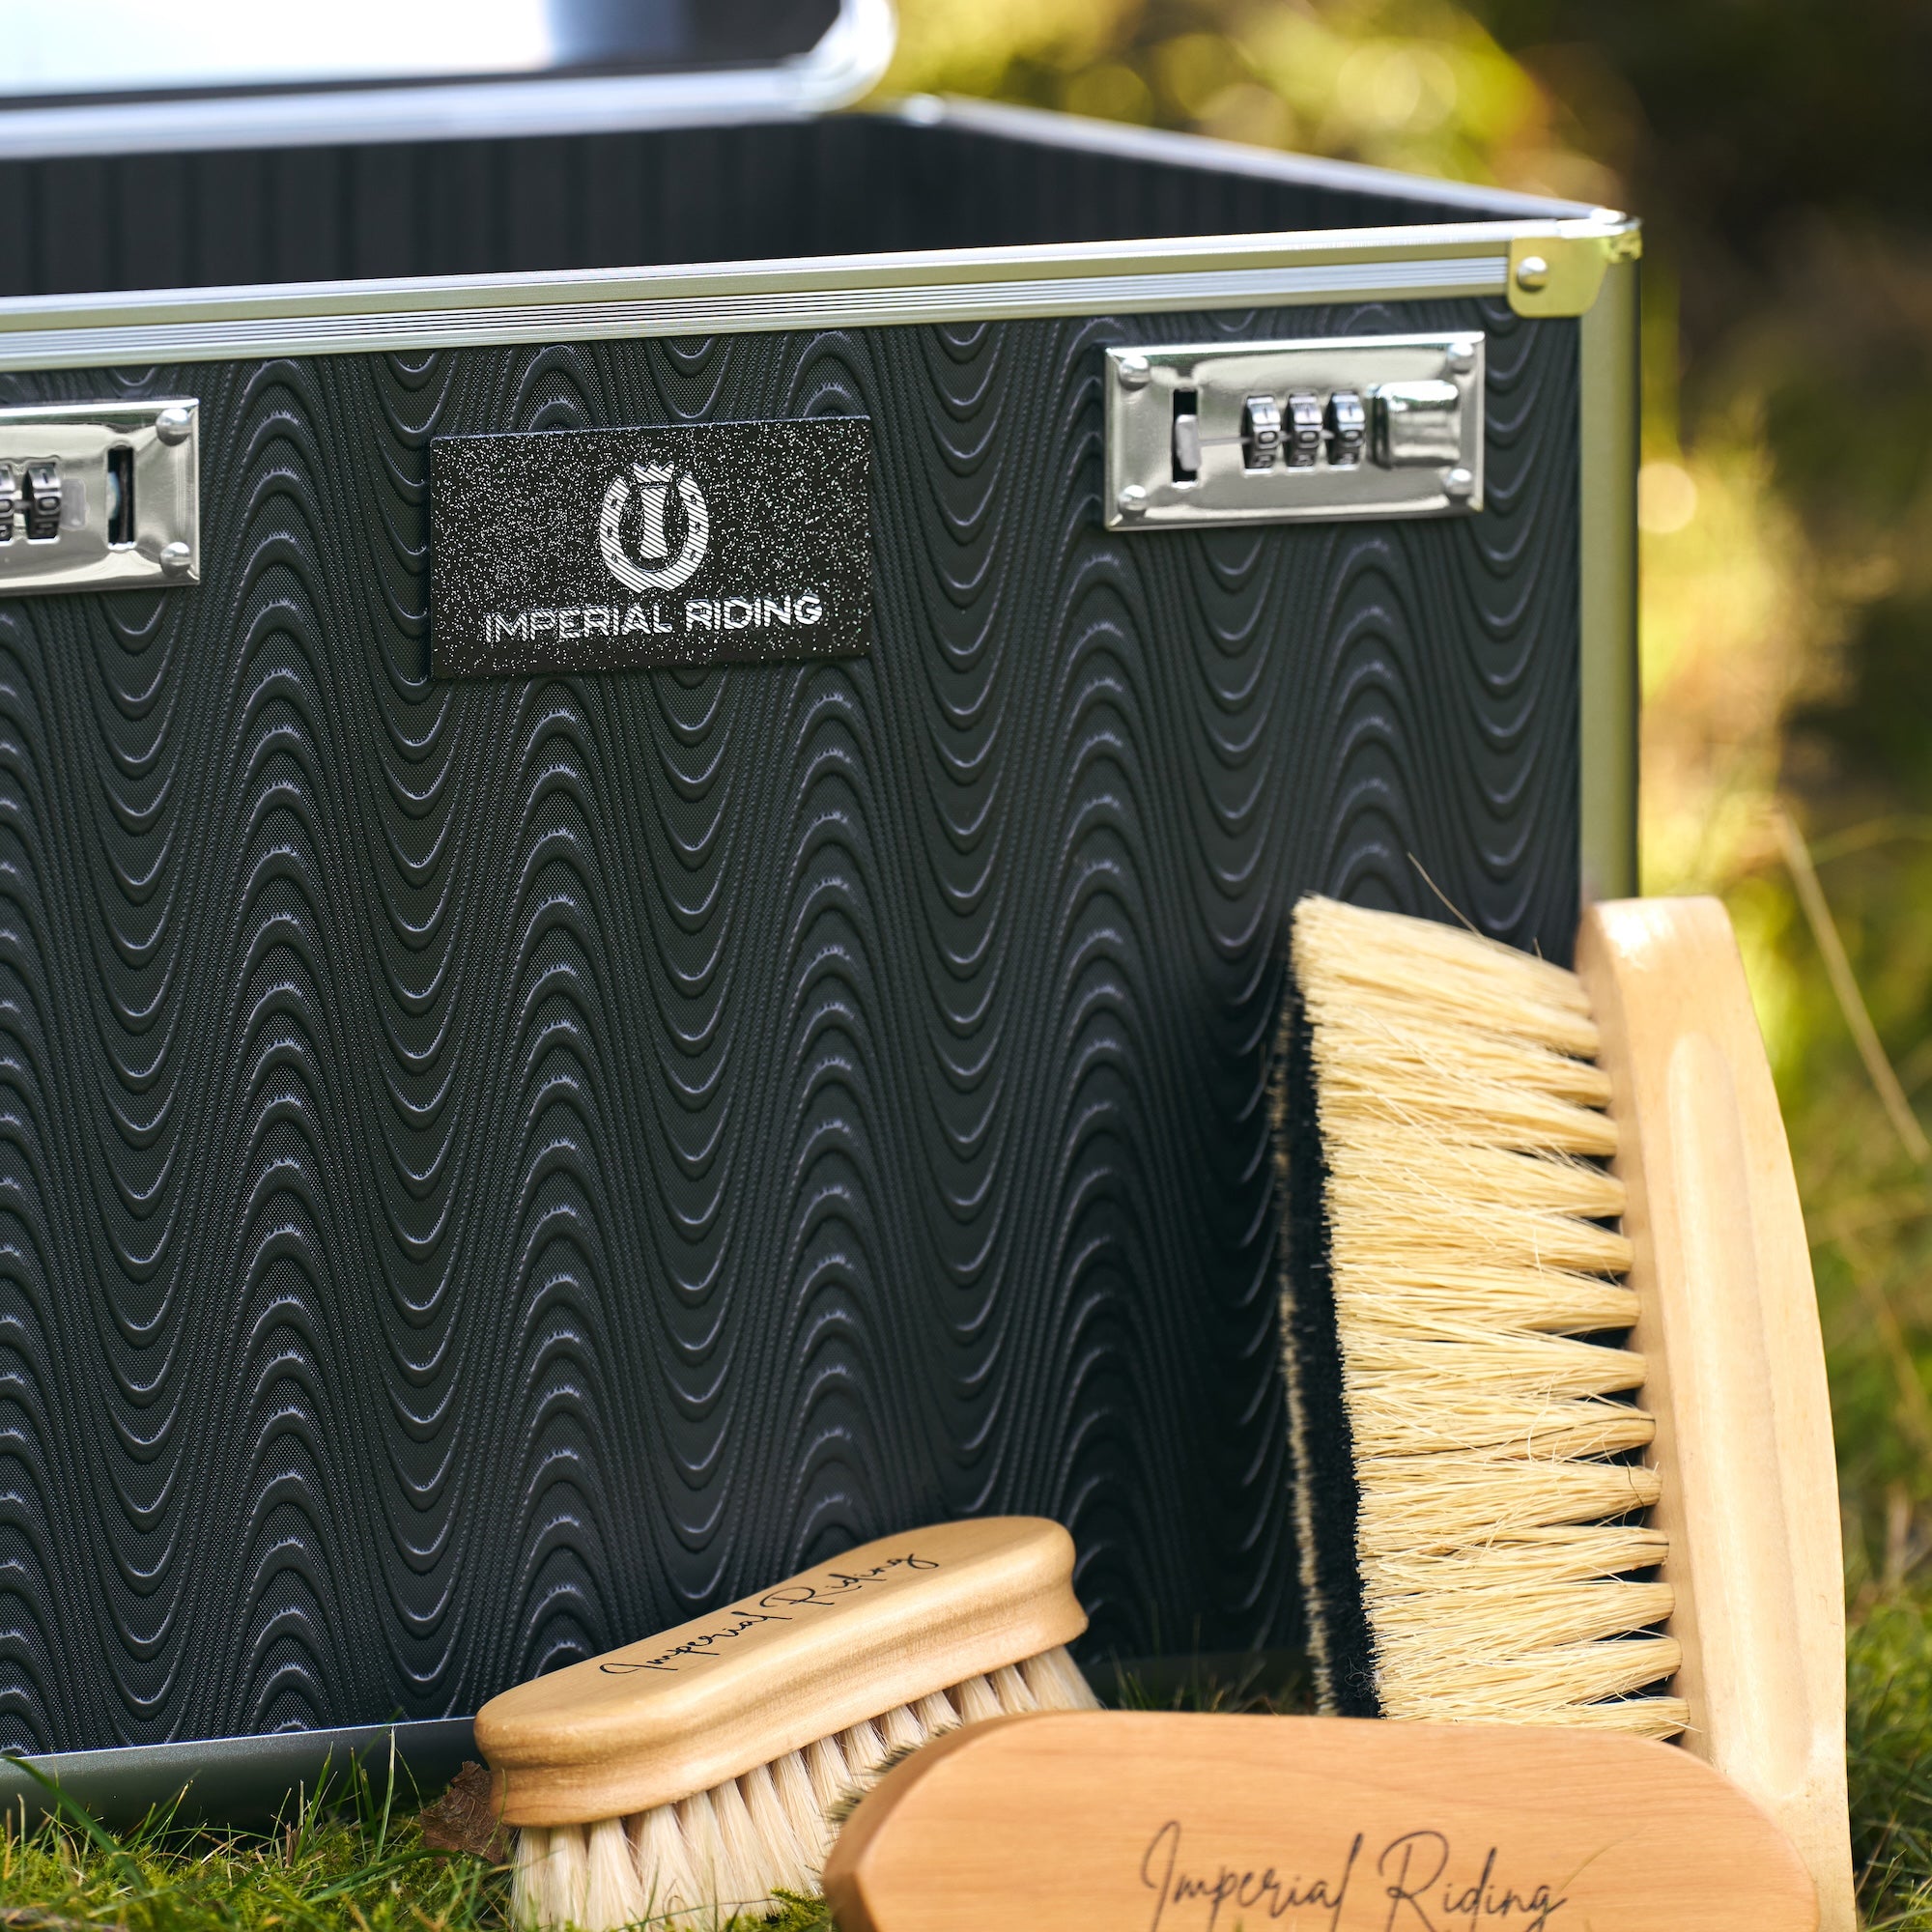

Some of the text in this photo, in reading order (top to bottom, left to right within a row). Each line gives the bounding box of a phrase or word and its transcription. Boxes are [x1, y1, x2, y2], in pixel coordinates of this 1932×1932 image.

[483, 594, 823, 643] IMPERIAL RIDING
[599, 1552, 940, 1674] Imperial Riding
[1141, 1820, 1568, 1932] Imperial Riding
